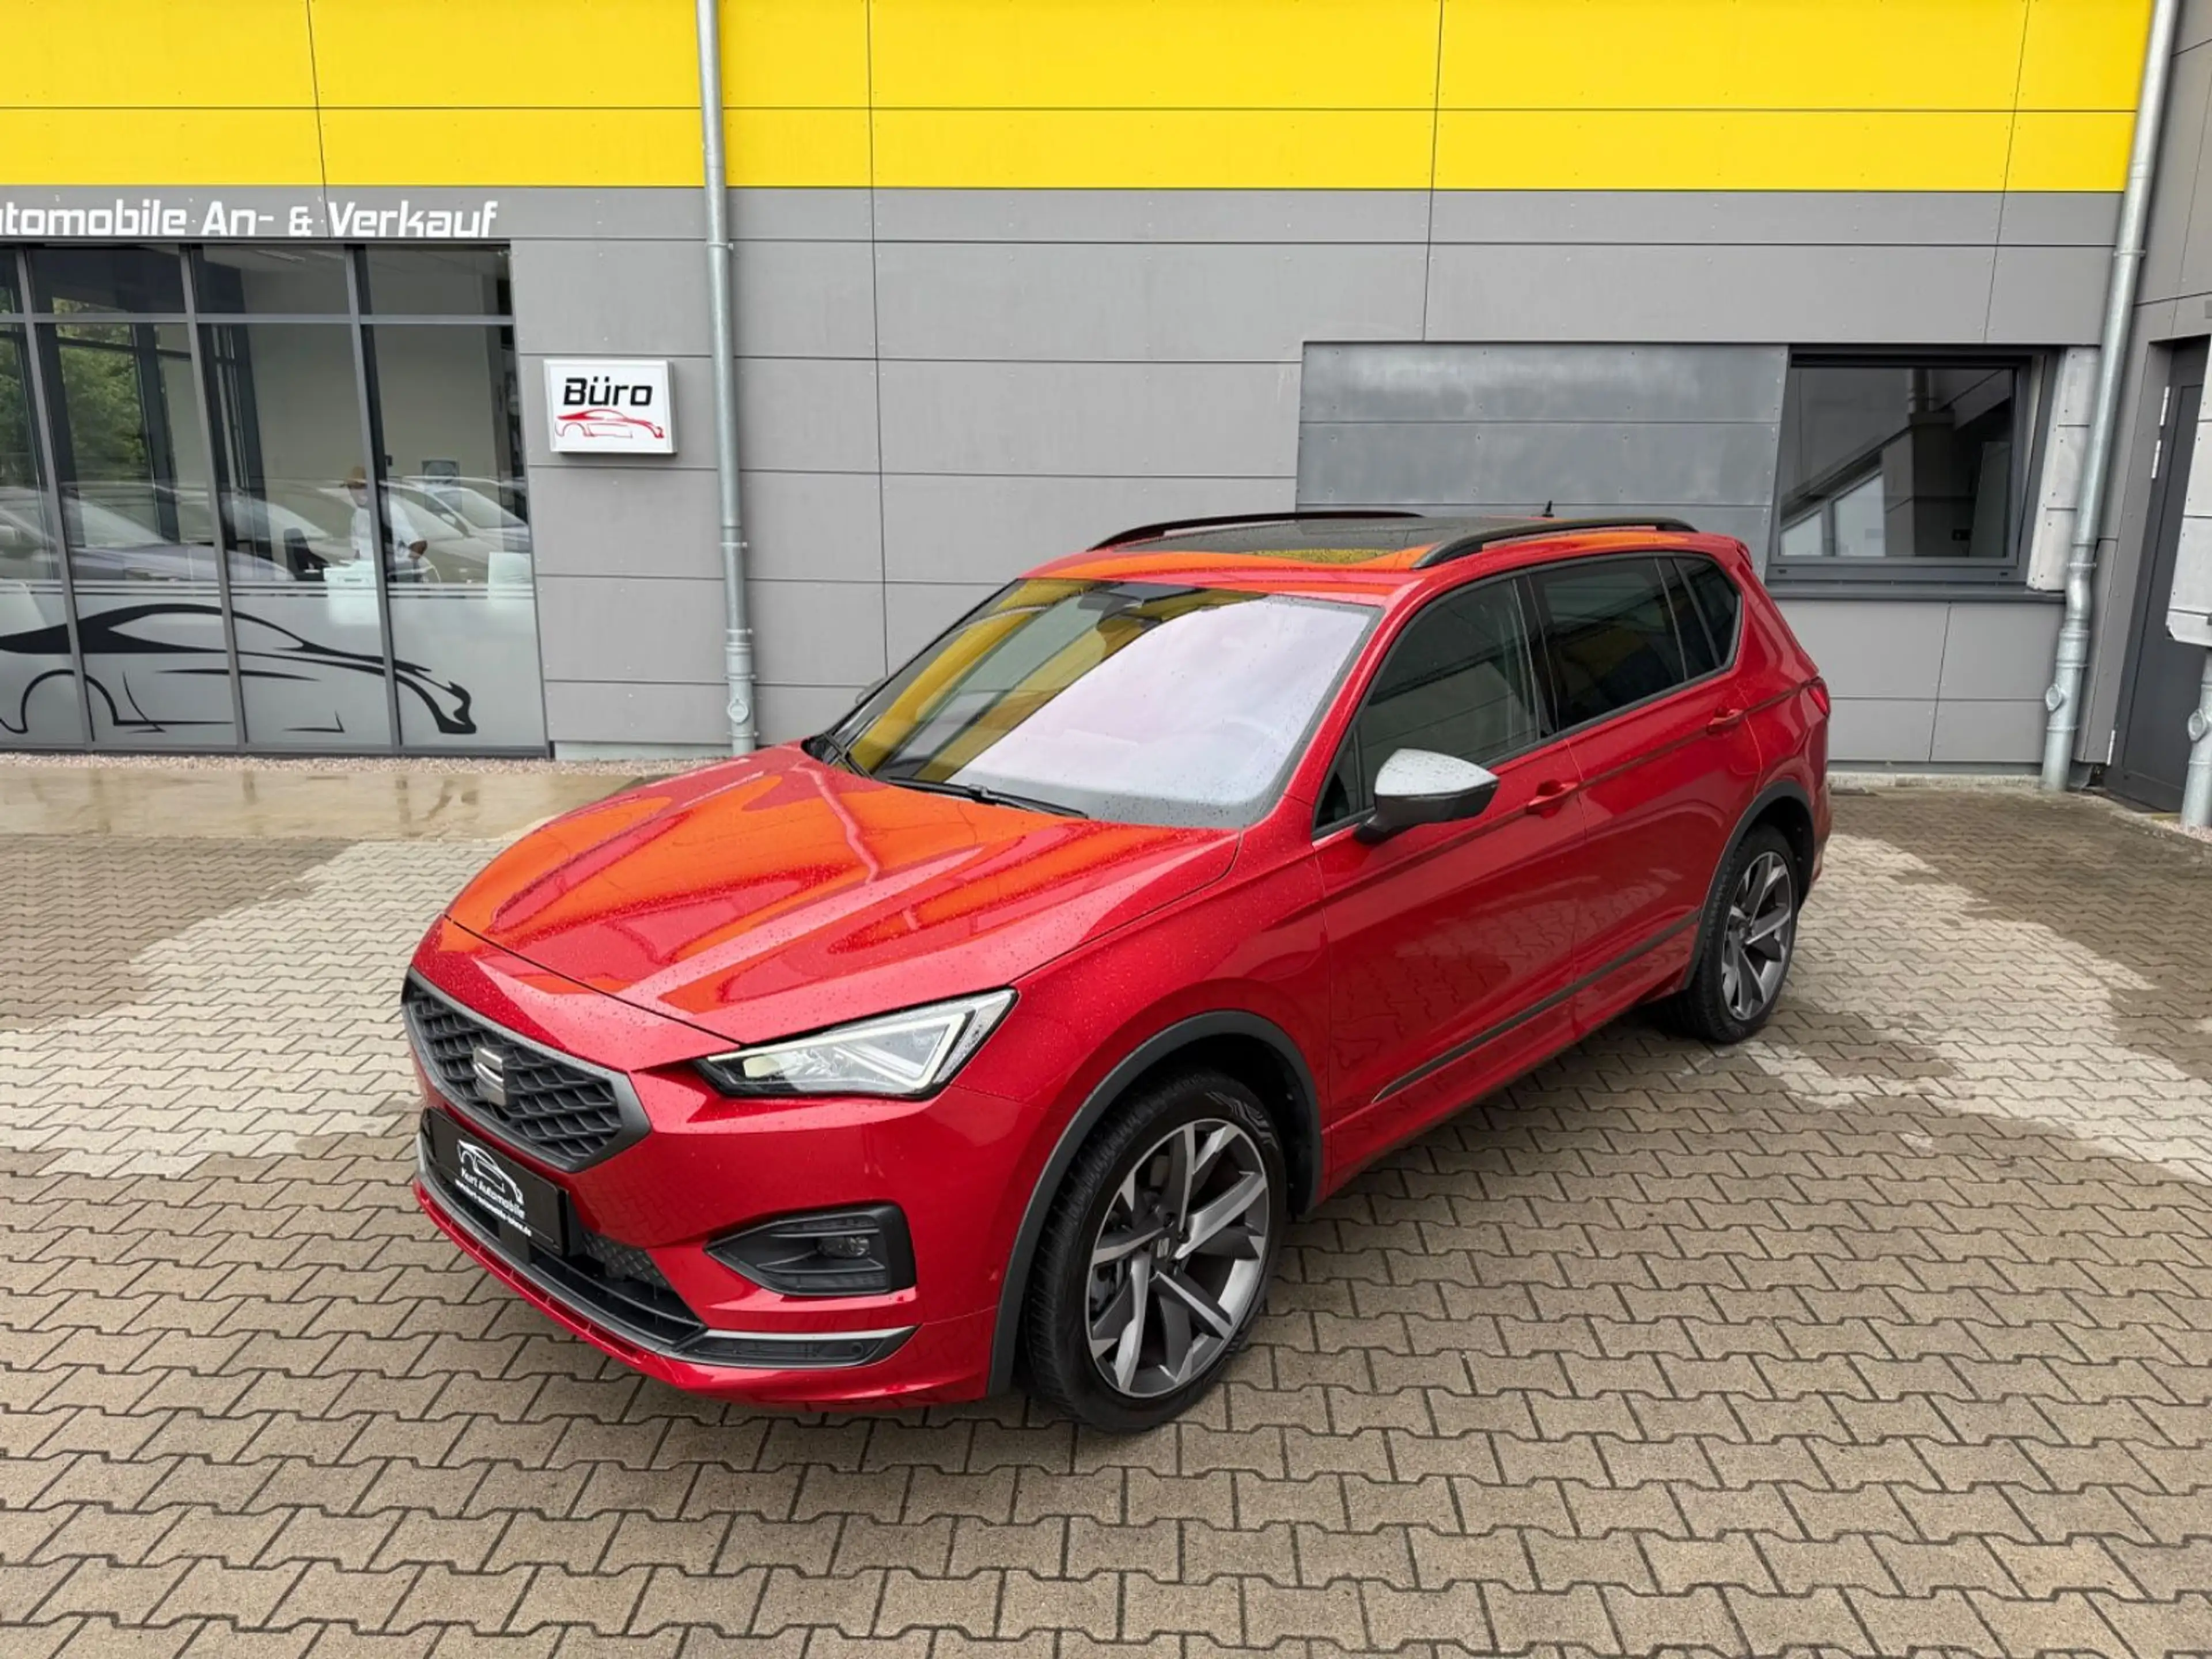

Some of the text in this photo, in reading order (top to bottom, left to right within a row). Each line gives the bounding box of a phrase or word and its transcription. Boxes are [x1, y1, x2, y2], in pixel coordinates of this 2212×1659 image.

[0, 199, 498, 238] tomobile An- & Verkauf
[563, 376, 653, 406] Büro
